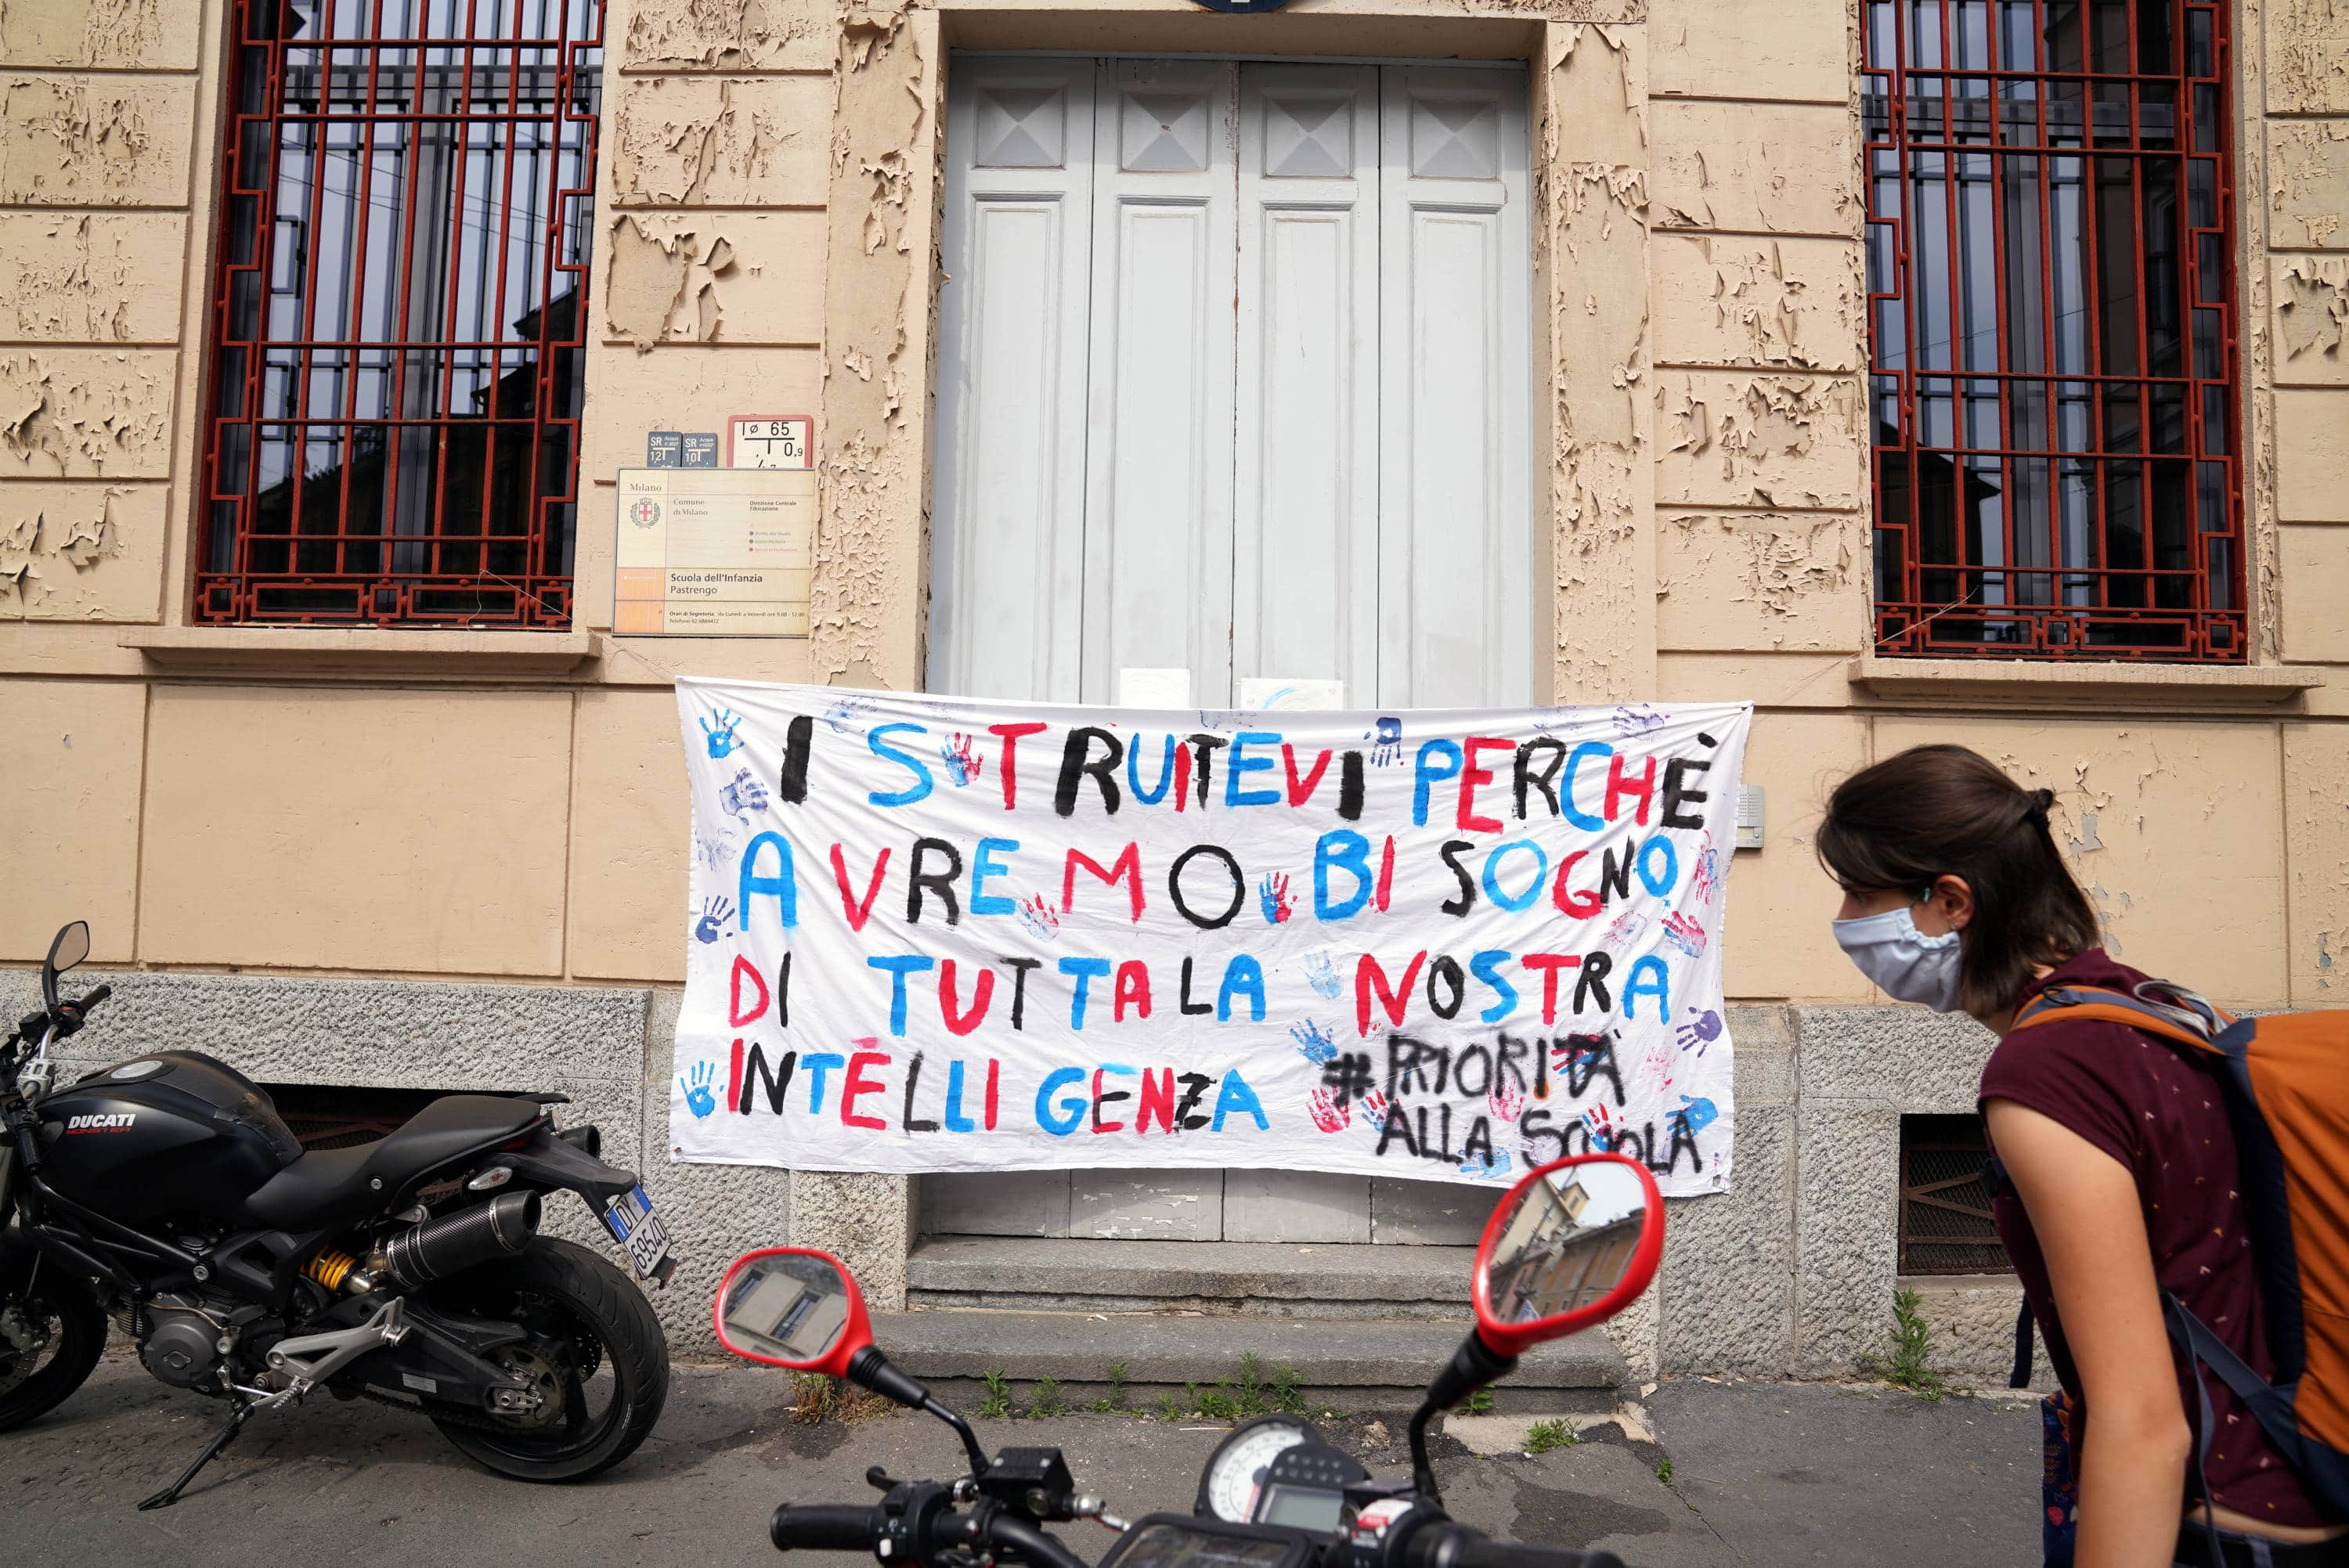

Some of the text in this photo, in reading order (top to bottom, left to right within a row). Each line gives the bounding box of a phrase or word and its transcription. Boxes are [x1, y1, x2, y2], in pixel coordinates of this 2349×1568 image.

[770, 422, 789, 436] 65
[650, 437, 662, 446] SR
[685, 438, 697, 448] SR
[630, 483, 662, 492] Milano
[671, 573, 763, 582] Scuola dell'Infanzia
[670, 586, 717, 596] Pastrengo
[739, 830, 1678, 932] AVREMO BISOGNO
[729, 950, 1671, 1037] DI TUTTA LA NOSTRA
[67, 1113, 136, 1129] DUCATI
[1376, 1103, 1493, 1168] ALLA
[615, 1196, 638, 1231] DY
[630, 1217, 667, 1270] 69540
